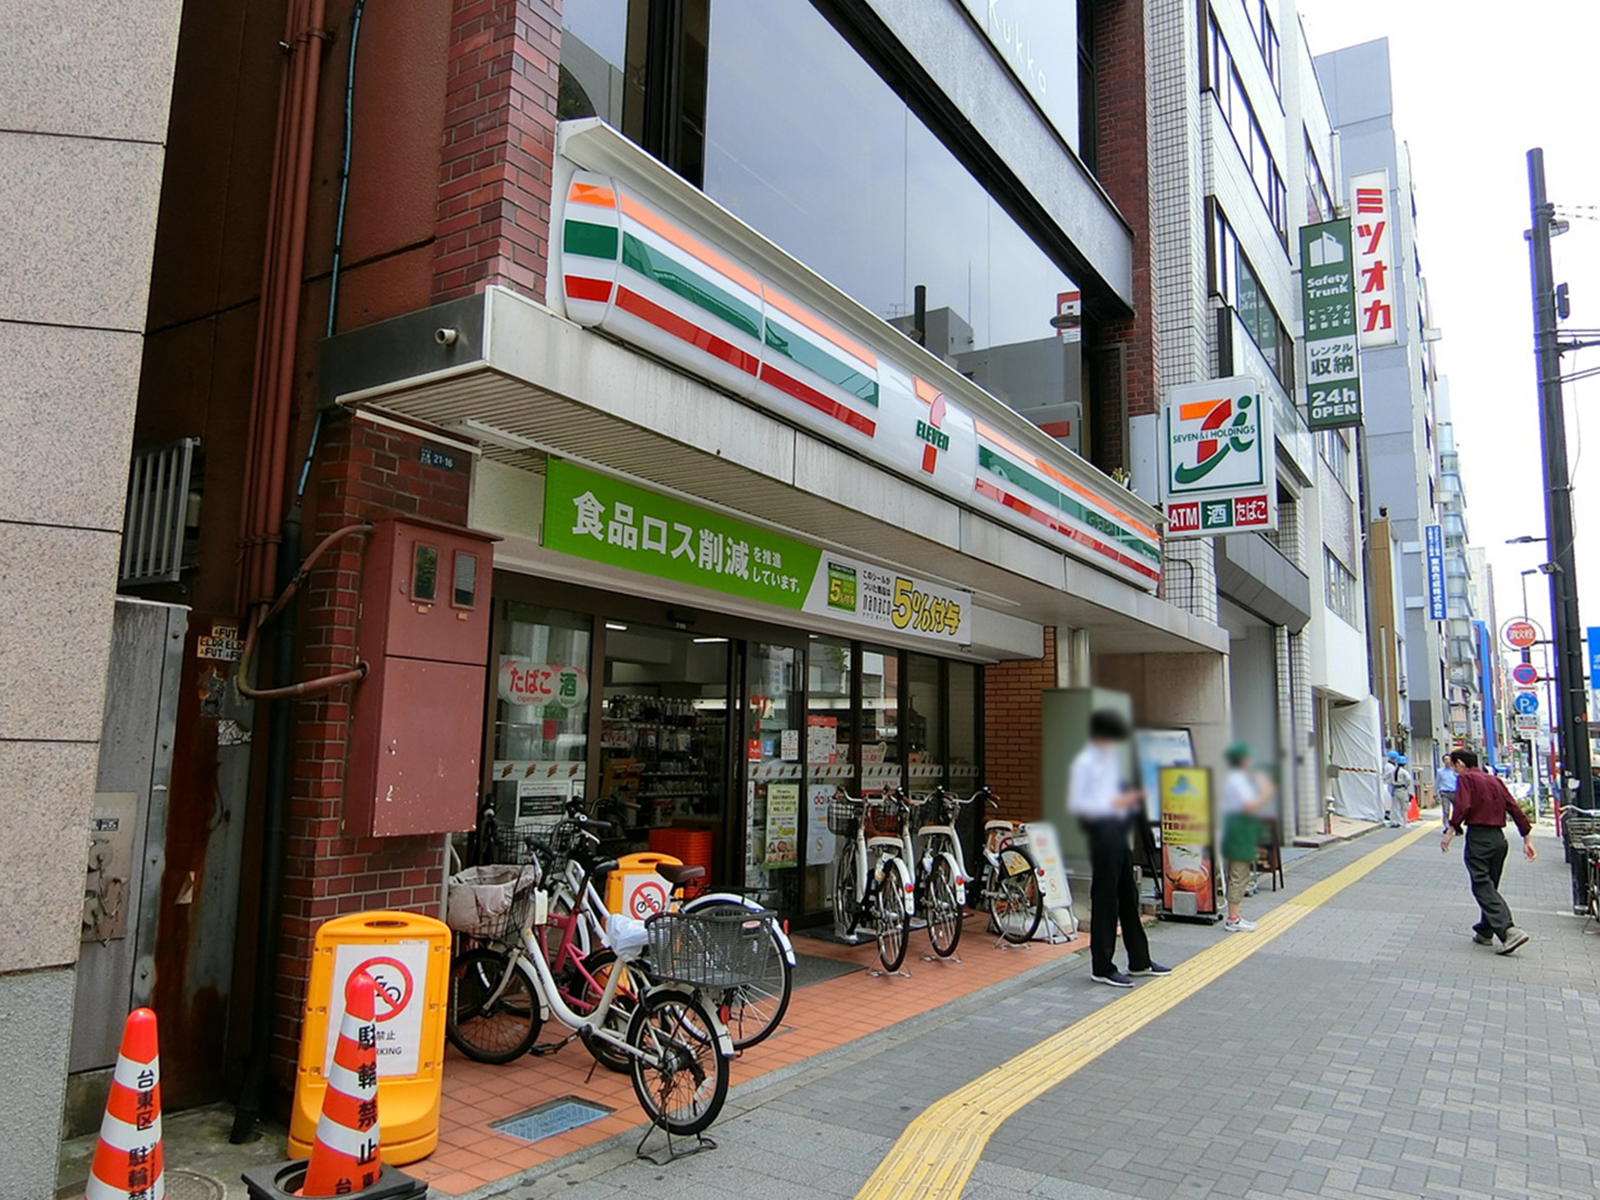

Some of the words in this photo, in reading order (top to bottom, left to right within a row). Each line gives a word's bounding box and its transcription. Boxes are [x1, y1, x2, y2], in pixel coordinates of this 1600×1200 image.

[1356, 188, 1391, 332] ミツオカ
[1307, 273, 1349, 288] Safety
[1307, 284, 1349, 299] Trunk
[1311, 343, 1353, 357] レンタル
[1311, 355, 1354, 377] 収納
[1312, 387, 1356, 406] 24h
[1312, 403, 1357, 419] OPEN
[1210, 425, 1255, 438] HOLDINGS
[1170, 505, 1198, 528] ATM
[1207, 503, 1227, 526] 酒
[1236, 501, 1267, 522] たばこ
[572, 491, 749, 580] 食品ロス削減
[753, 566, 800, 593] しています。
[891, 576, 961, 635] 5%付与
[509, 667, 552, 695] たばこ
[559, 671, 577, 698] 酒
[376, 1029, 396, 1041] 禁止
[136, 1069, 154, 1132] 台東区
[357, 1023, 377, 1167] 駐輪禁止
